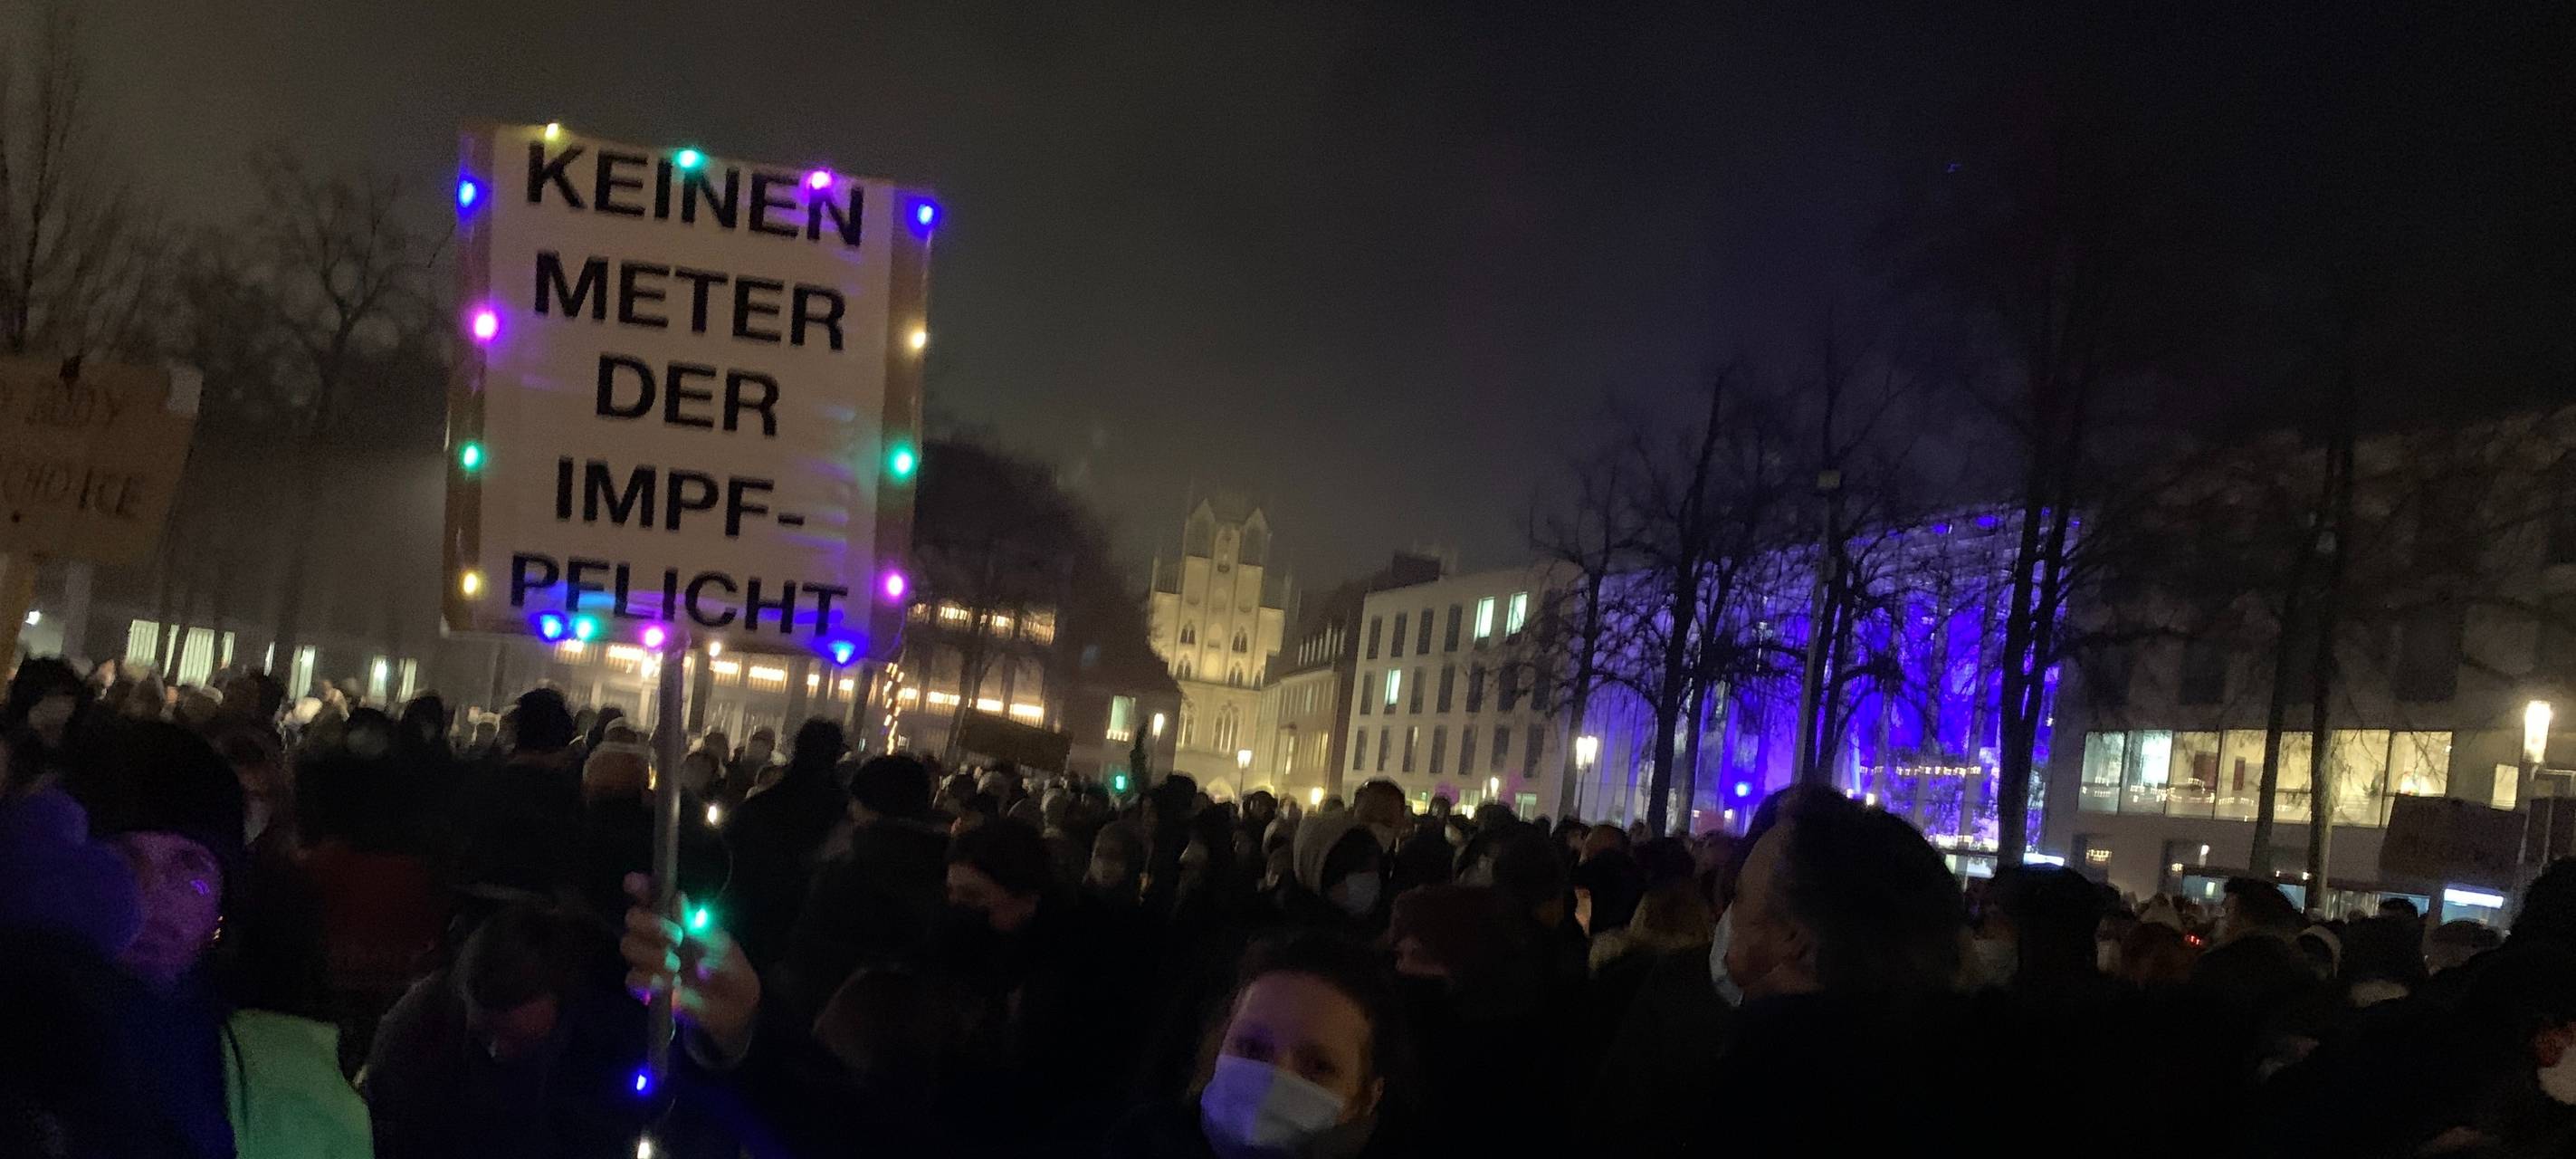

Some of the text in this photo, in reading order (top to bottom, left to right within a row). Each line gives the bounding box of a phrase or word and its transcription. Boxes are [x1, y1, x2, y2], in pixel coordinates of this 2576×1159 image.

[526, 141, 864, 246] KEINEN
[534, 250, 846, 351] METER
[596, 353, 780, 437] DER
[556, 455, 806, 539] IMPF-
[510, 551, 848, 636] PFLICHT
